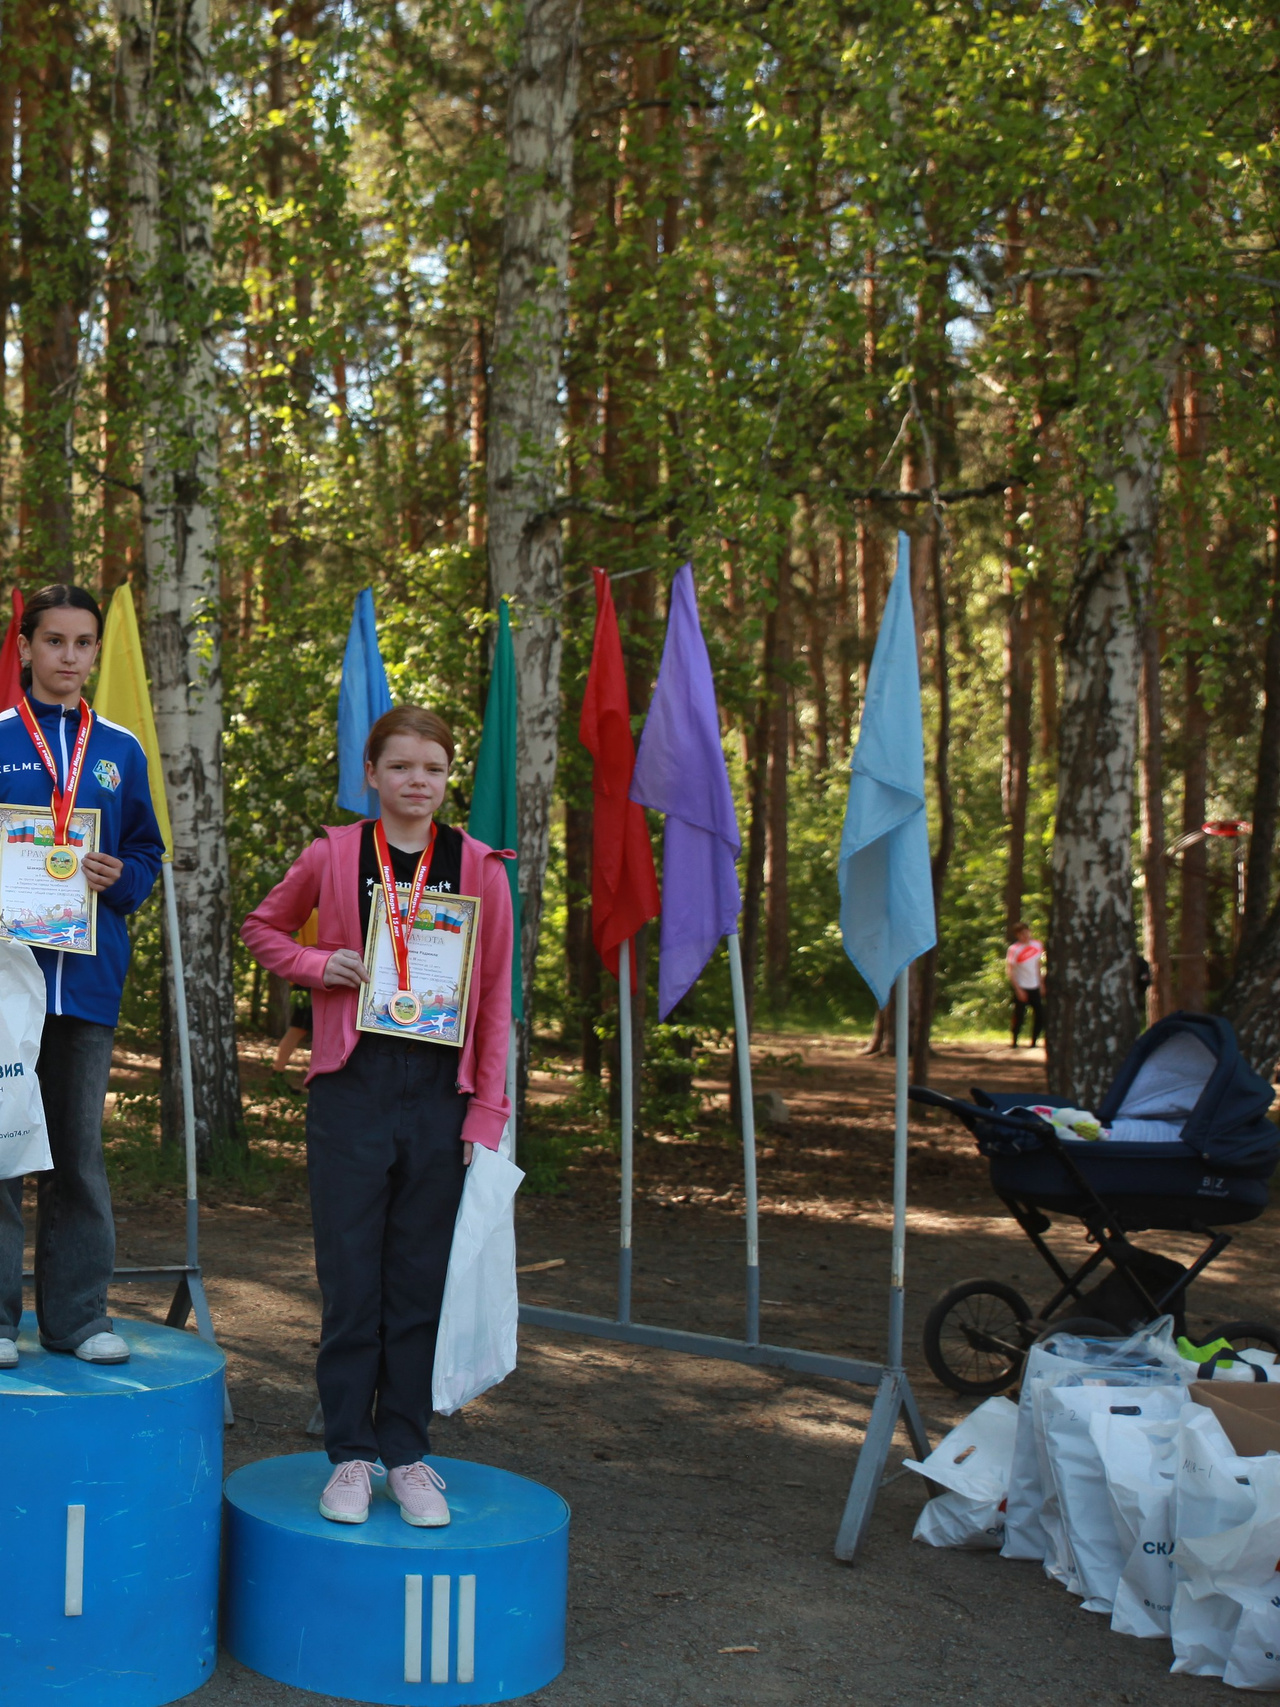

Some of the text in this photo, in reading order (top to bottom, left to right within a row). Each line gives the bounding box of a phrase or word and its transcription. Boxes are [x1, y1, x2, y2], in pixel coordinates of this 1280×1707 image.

[73, 747, 82, 767] Марья
[383, 865, 391, 882] Иван
[418, 865, 427, 881] Иван
[385, 882, 393, 891] да
[415, 882, 421, 891] да
[388, 892, 397, 914] Марья
[403, 1574, 476, 1684] III
